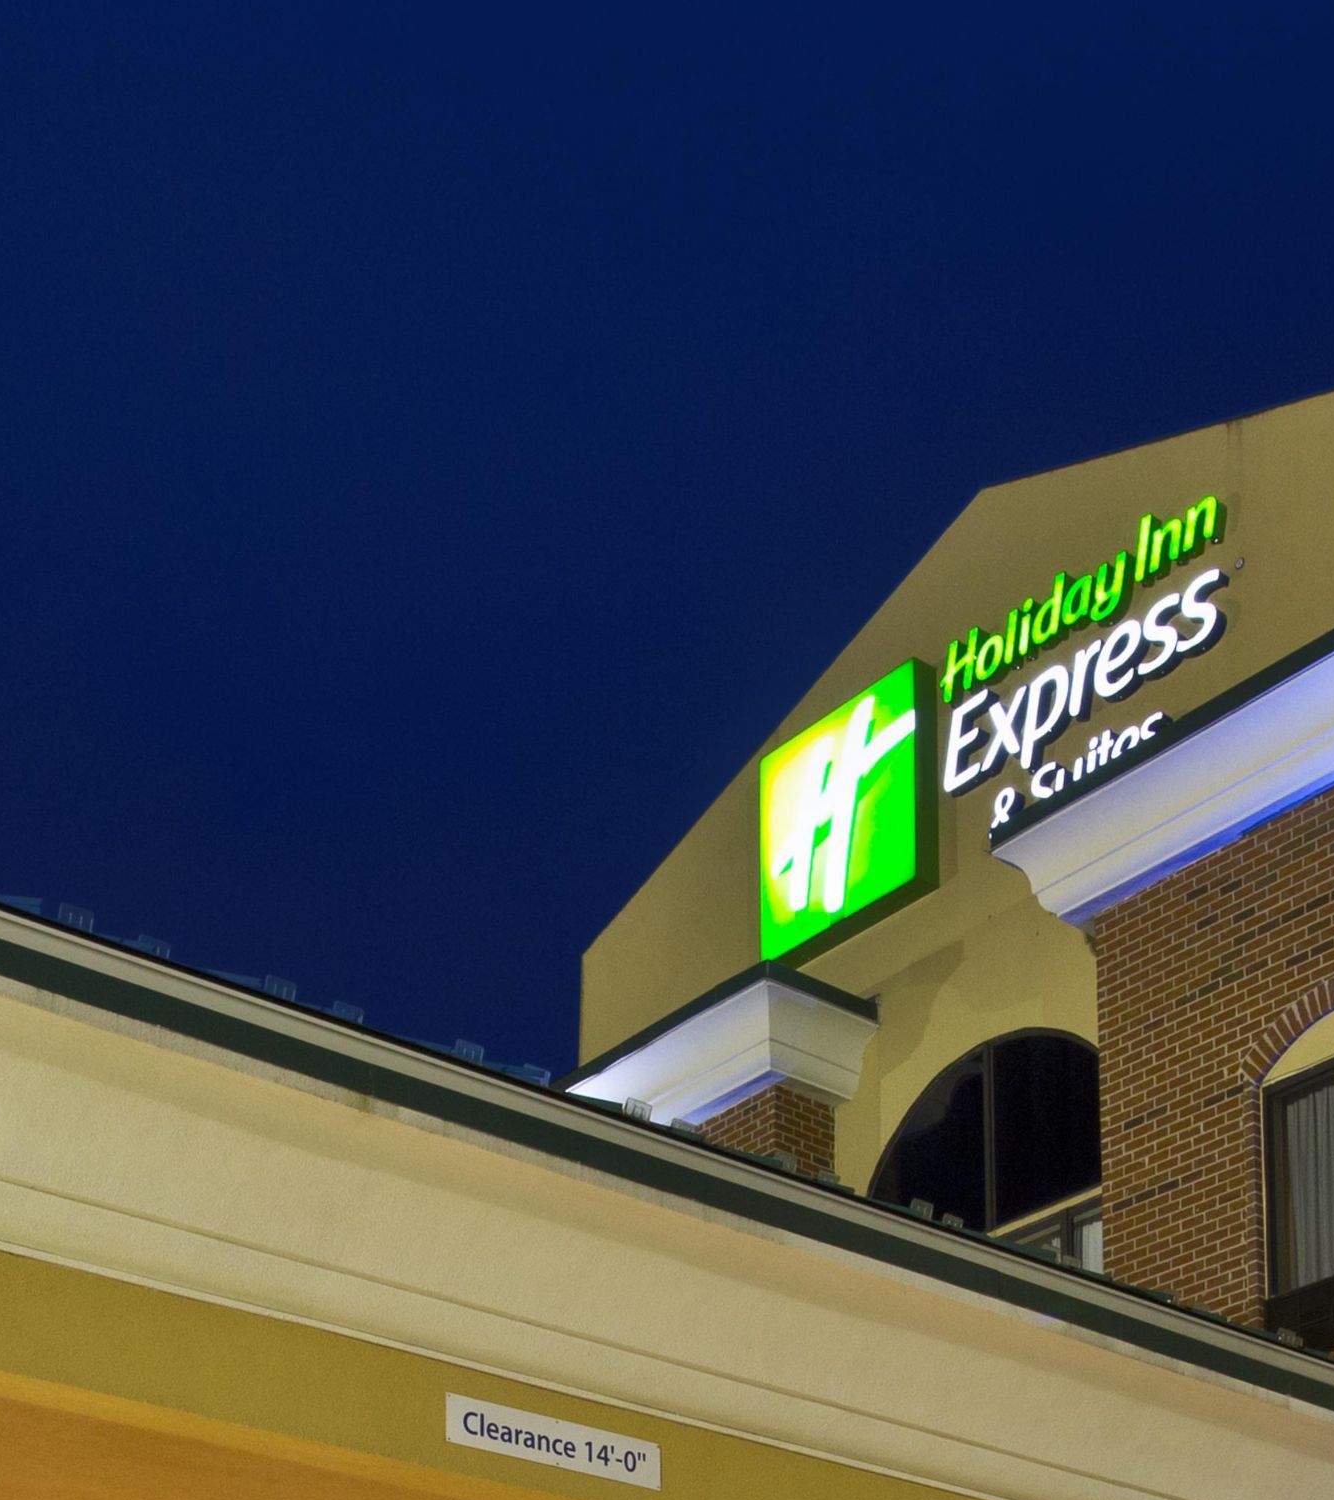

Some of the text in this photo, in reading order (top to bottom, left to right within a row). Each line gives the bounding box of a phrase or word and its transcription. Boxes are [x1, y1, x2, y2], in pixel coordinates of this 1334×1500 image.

[940, 496, 1217, 703] Holiday Inn
[943, 568, 1220, 793] Express
[462, 1411, 647, 1473] Clearance 14'-0"
